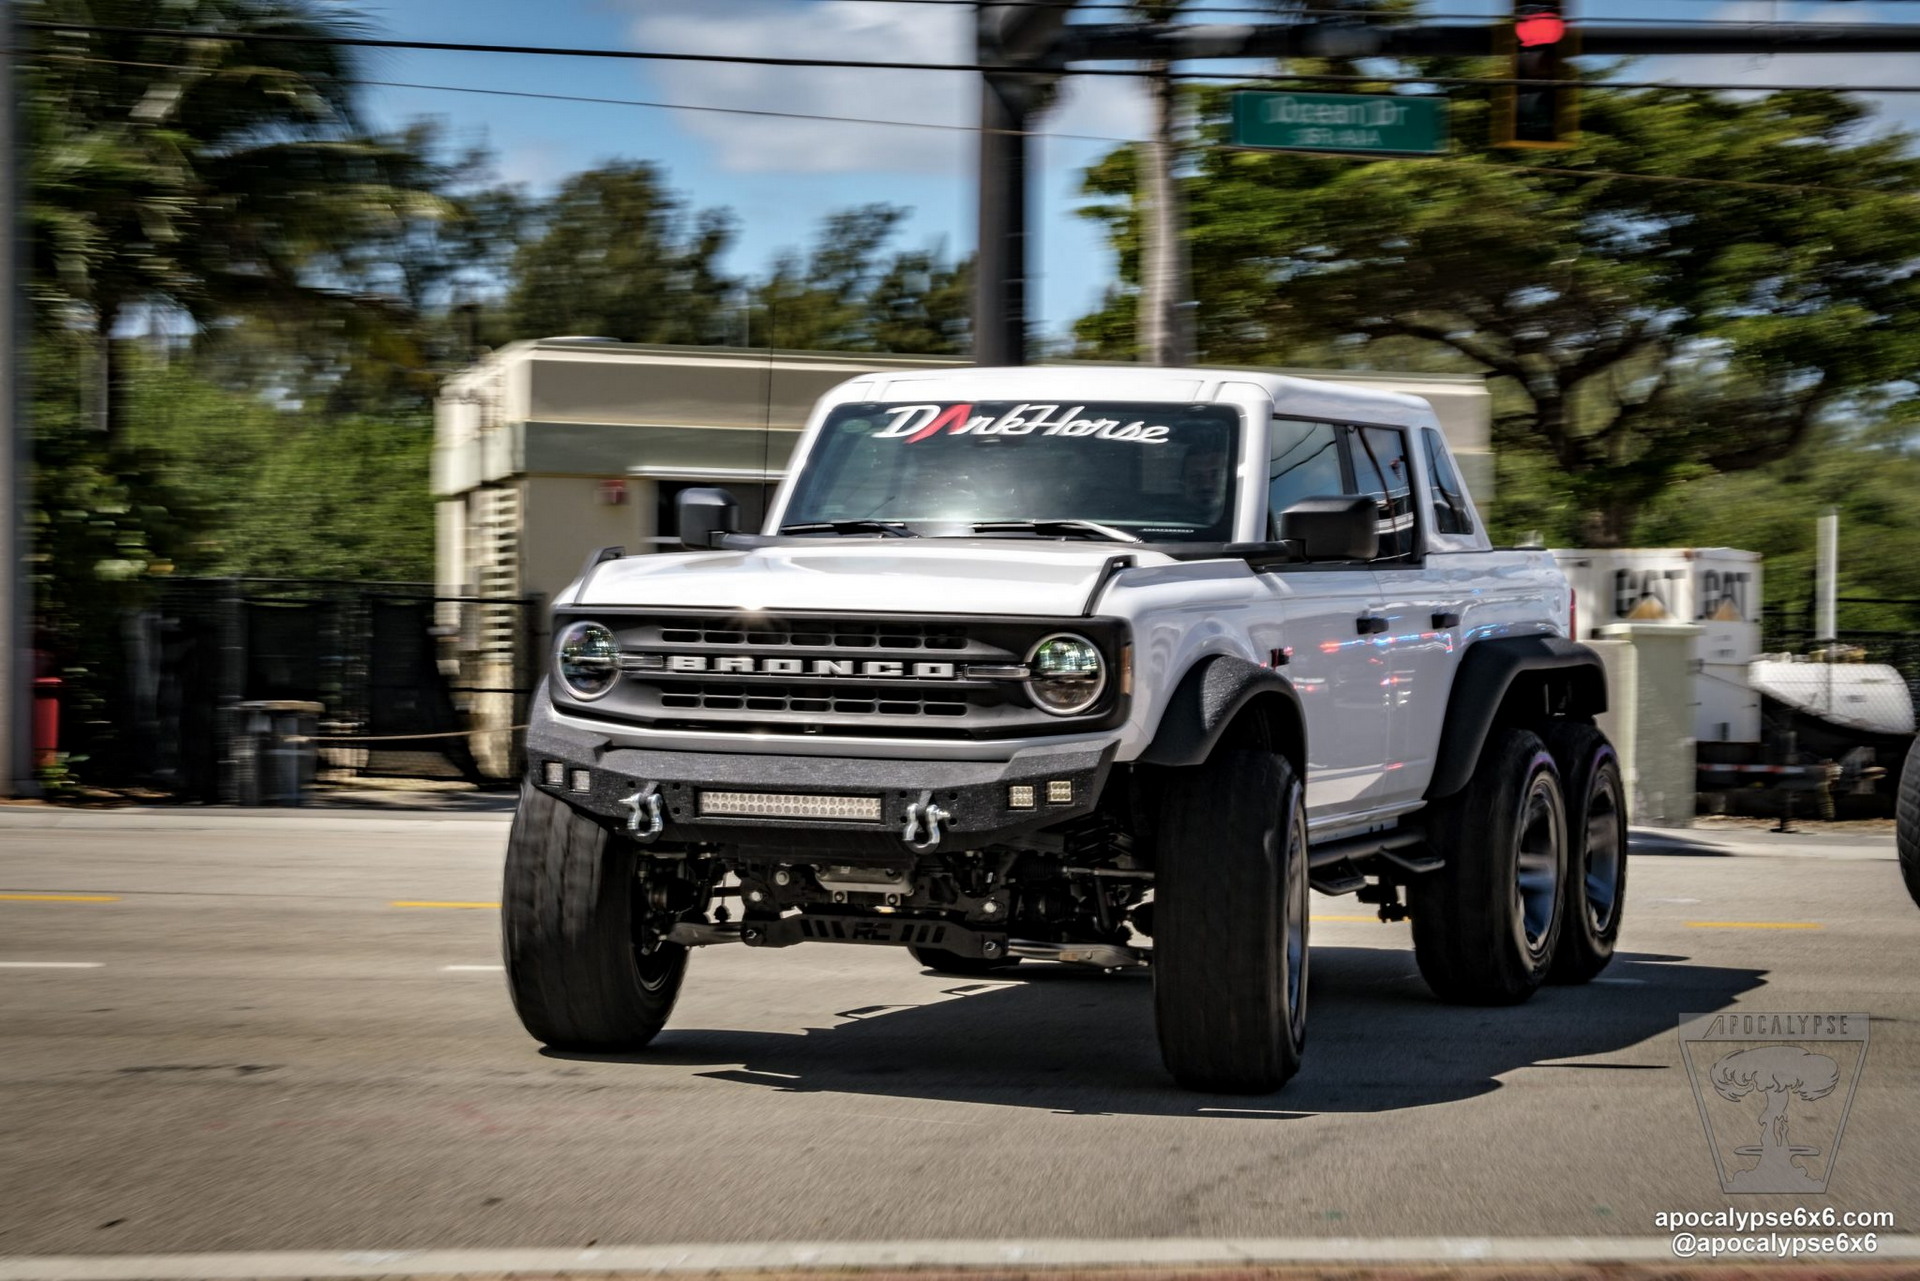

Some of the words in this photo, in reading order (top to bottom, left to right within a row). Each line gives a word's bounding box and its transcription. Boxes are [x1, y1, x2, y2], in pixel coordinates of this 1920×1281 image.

[1613, 568, 1690, 619] CAT
[1702, 569, 1751, 620] CAT
[666, 655, 955, 679] BRONCO
